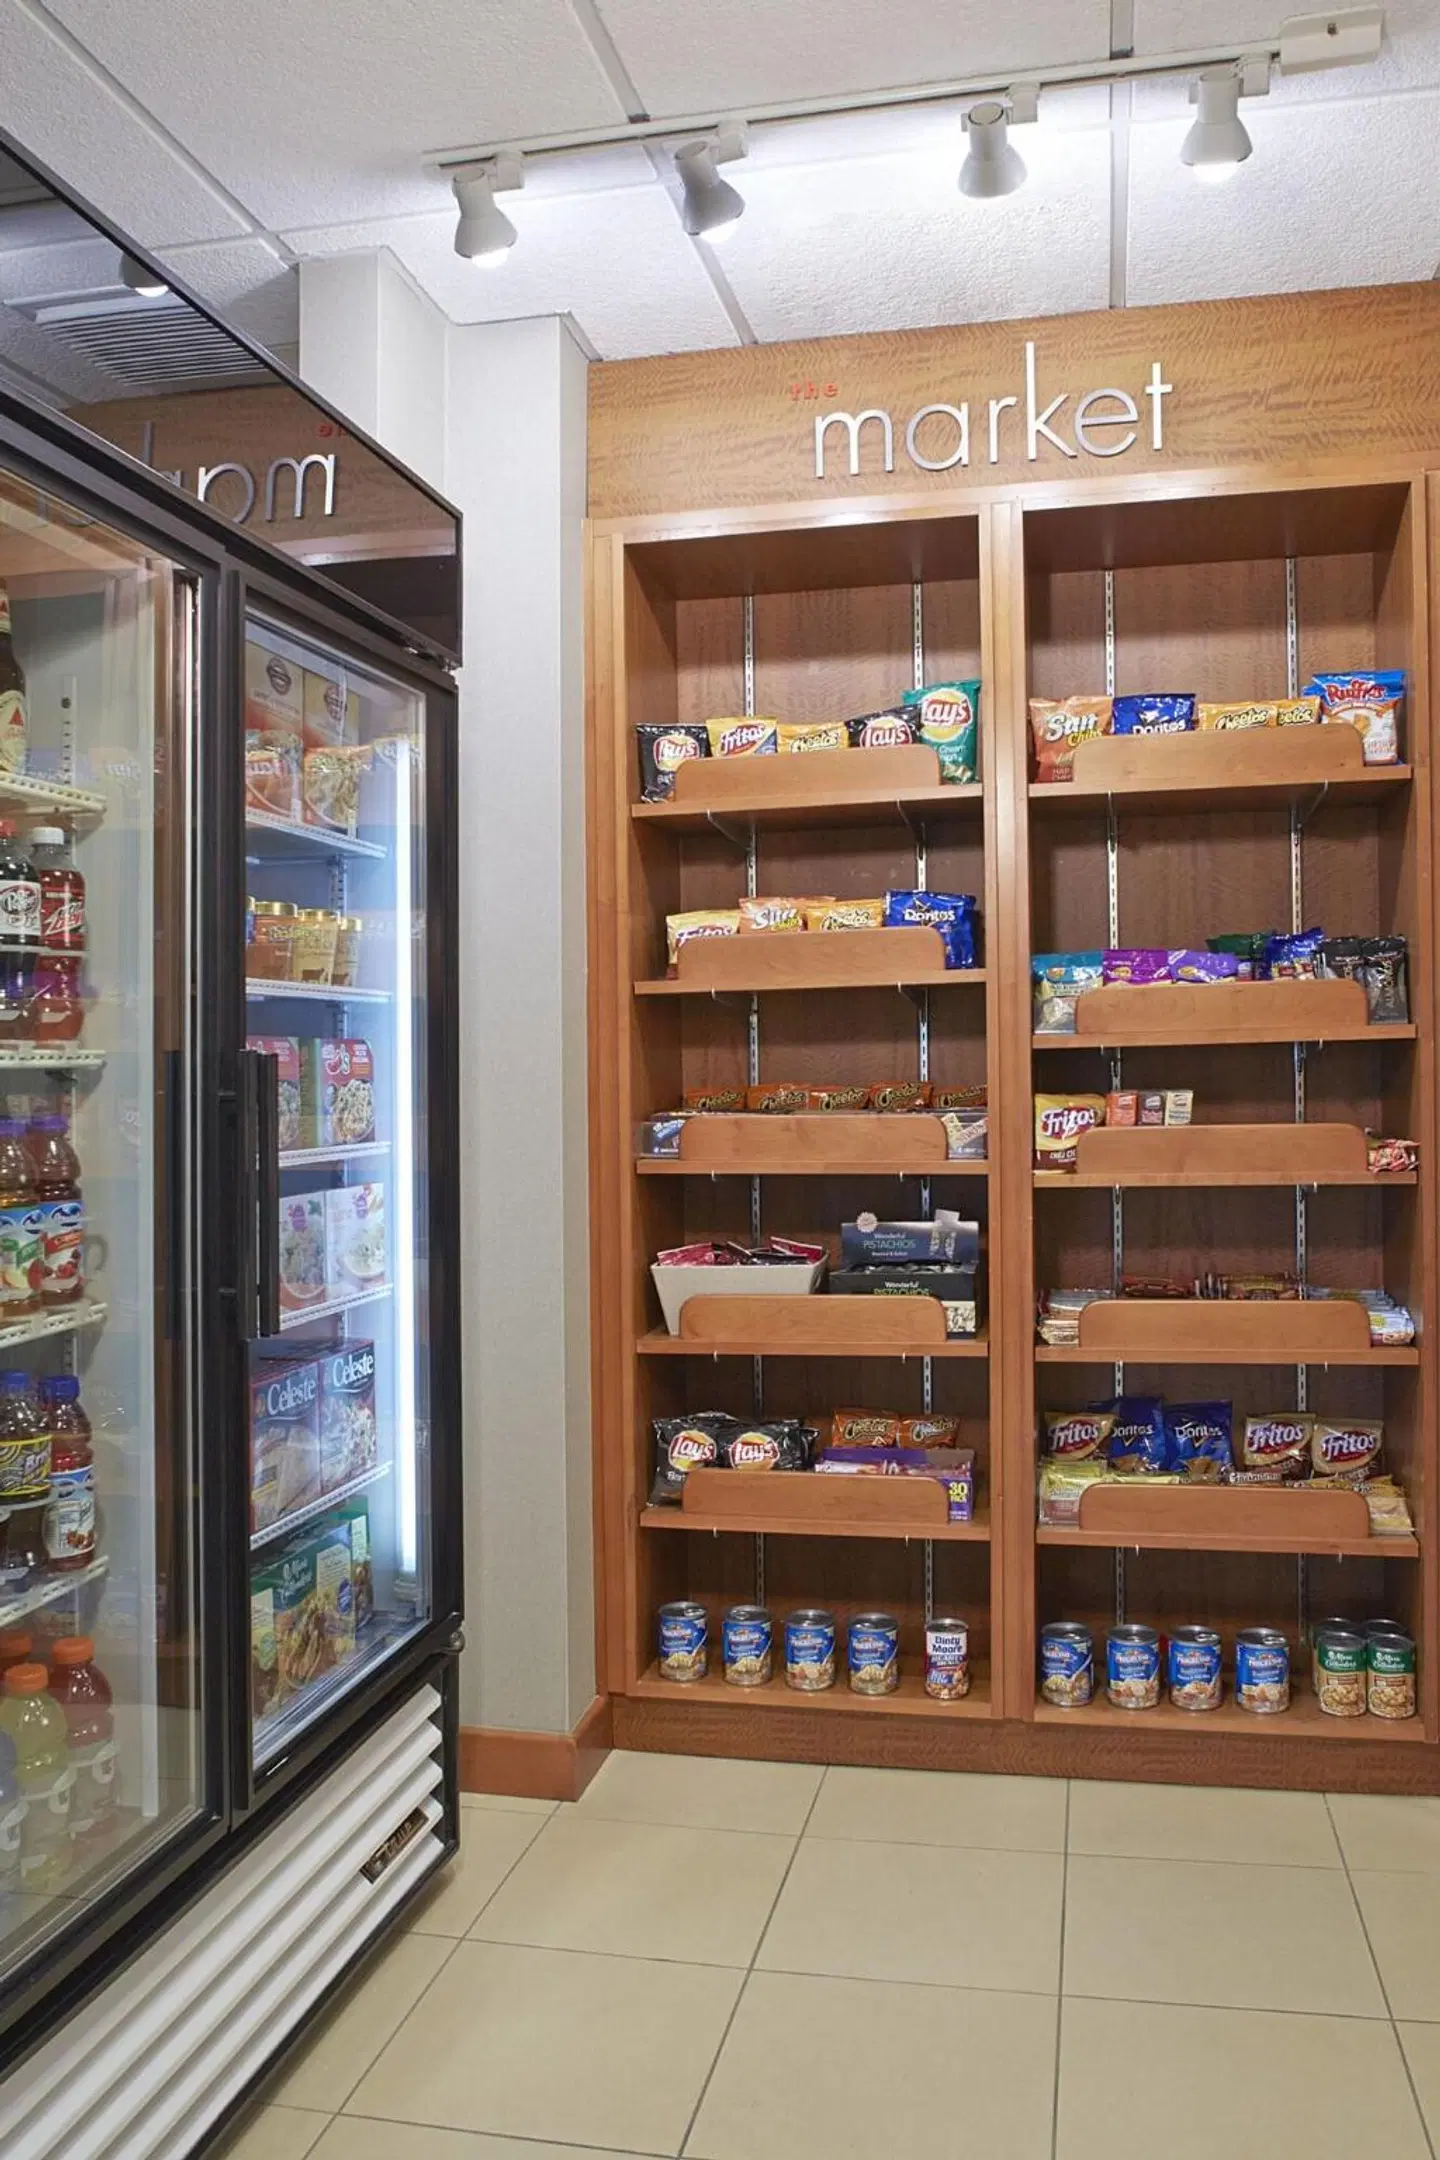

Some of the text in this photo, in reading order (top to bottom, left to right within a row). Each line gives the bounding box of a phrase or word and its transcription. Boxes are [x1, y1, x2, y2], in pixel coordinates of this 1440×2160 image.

[790, 376, 839, 400] the
[813, 341, 1174, 479] market
[1326, 679, 1386, 702] Ruffles
[720, 724, 766, 752] Fritos
[1045, 711, 1098, 742] Sun
[903, 908, 955, 921] Doritos
[1041, 1106, 1096, 1137] Fritos
[863, 1239, 917, 1249] PISTACHIOS
[885, 1281, 920, 1289] Wonderful
[333, 1352, 374, 1387] Celeste
[267, 1377, 316, 1416] Celeste
[1050, 1423, 1099, 1450] Fritos
[1175, 1424, 1223, 1438] Doritos
[1248, 1421, 1305, 1451] Fritos
[1321, 1433, 1377, 1460] Fritos
[949, 1482, 968, 1495] 30
[932, 1644, 963, 1654] Moore
[934, 1635, 961, 1645] Dinty
